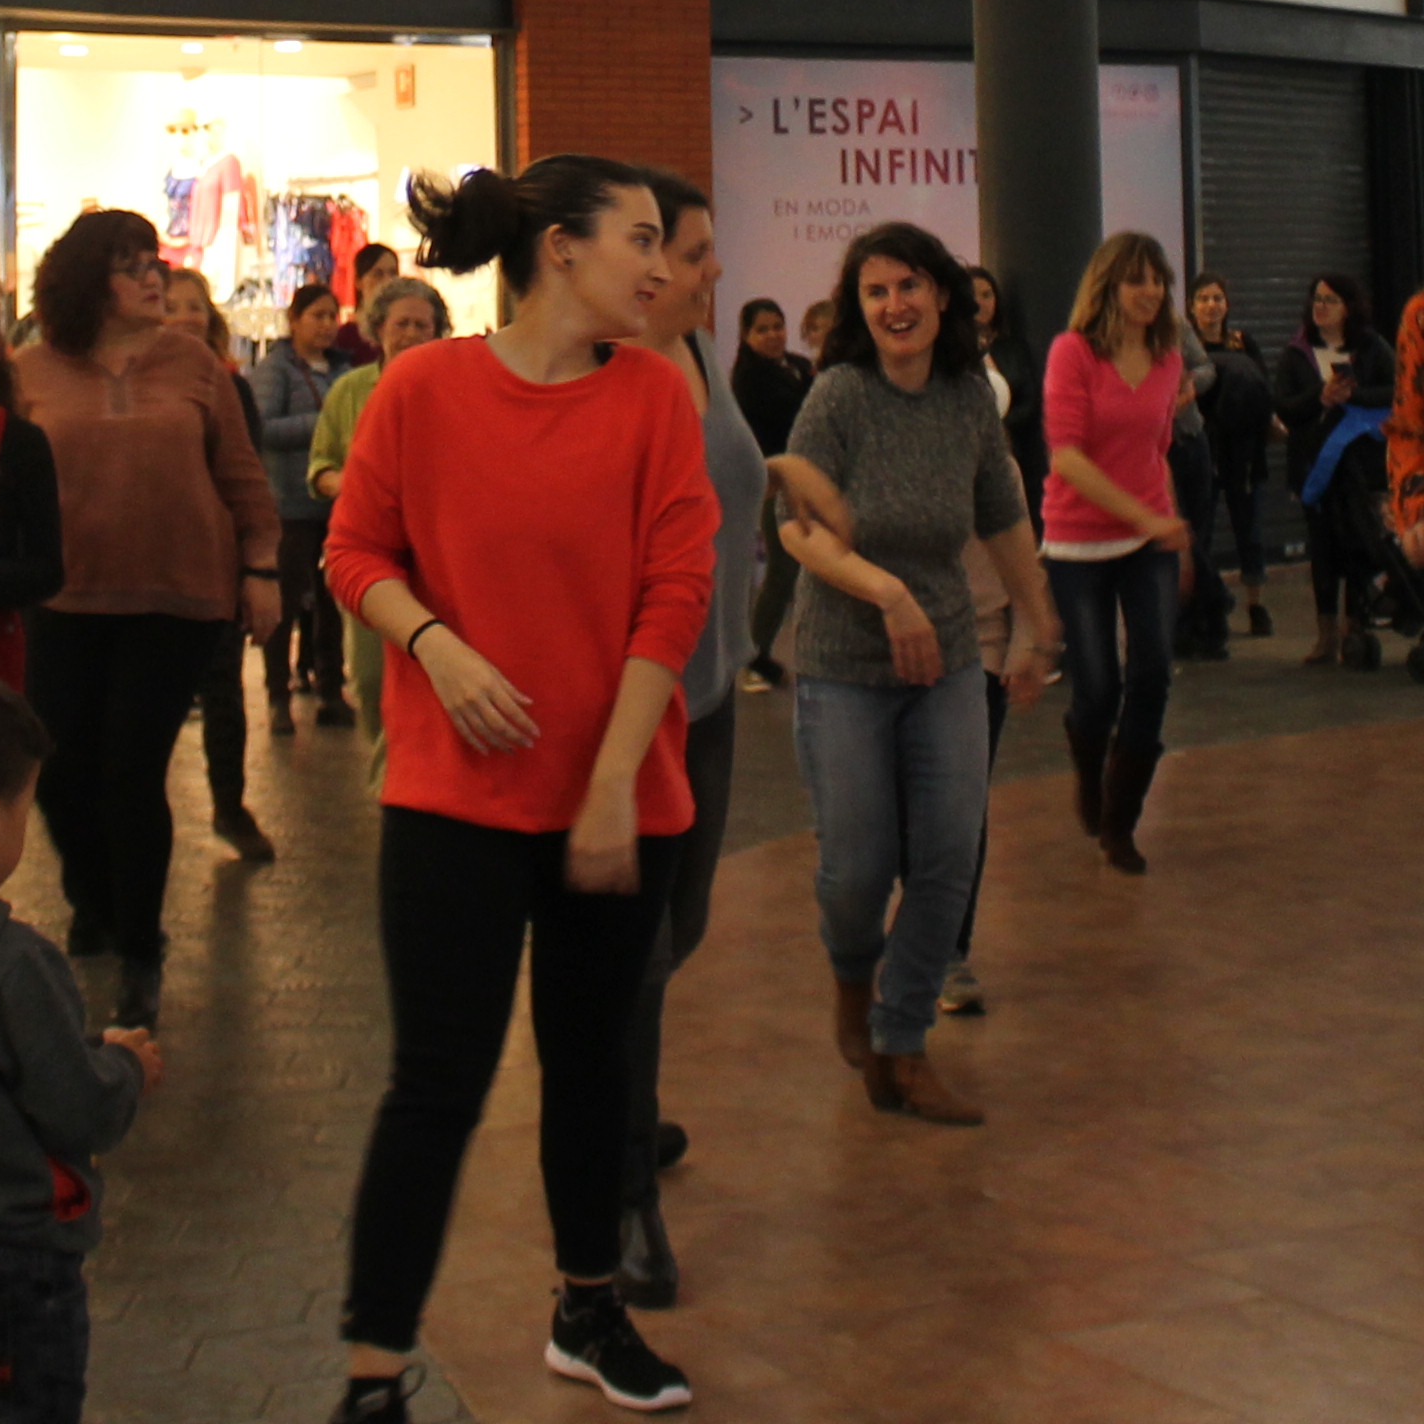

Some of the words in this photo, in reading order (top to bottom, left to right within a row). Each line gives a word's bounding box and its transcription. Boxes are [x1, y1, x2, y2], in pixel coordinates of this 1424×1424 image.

[772, 97, 919, 135] L'ESPAI
[774, 200, 799, 216] EN
[807, 200, 871, 216] MODA
